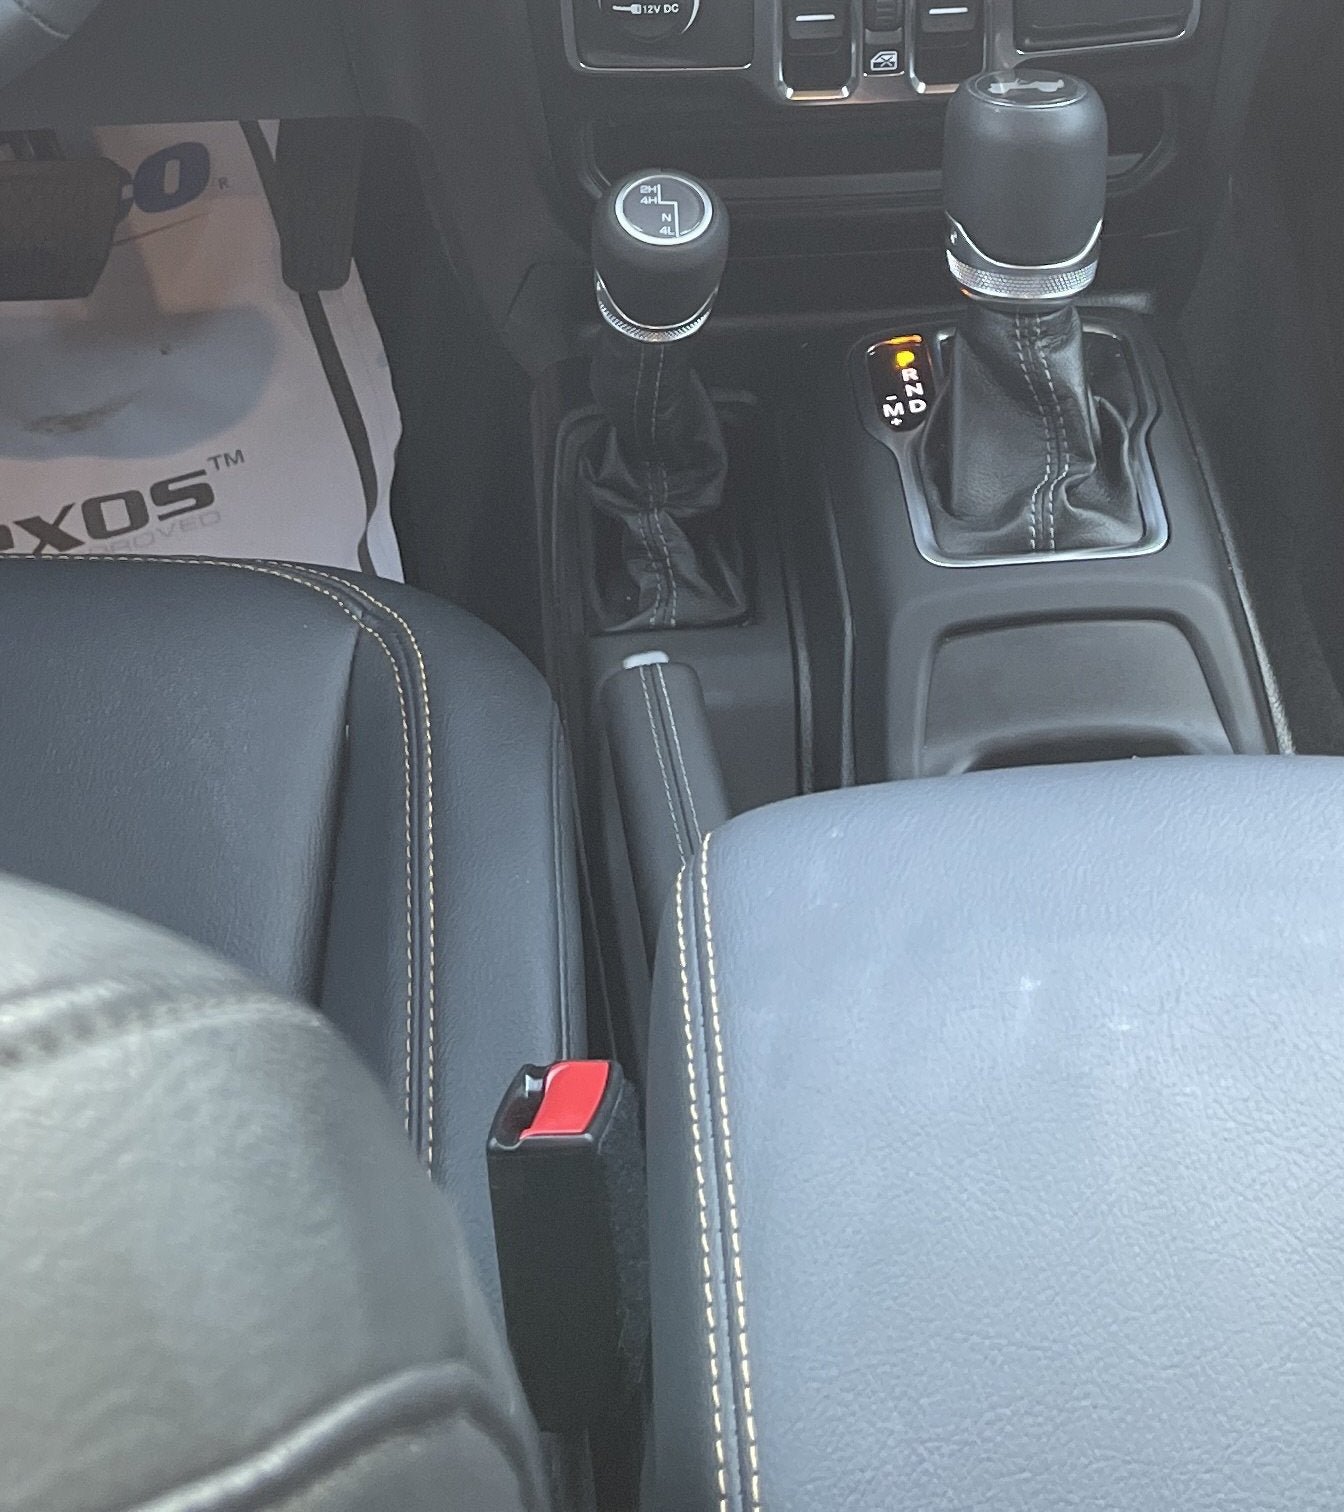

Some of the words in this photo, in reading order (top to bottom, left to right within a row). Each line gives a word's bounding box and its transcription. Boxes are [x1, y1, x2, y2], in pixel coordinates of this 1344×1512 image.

[643, 4, 661, 14] 12V
[664, 3, 680, 14] DC
[640, 185, 657, 194] 2H
[640, 196, 657, 205] 4H
[662, 213, 672, 222] N
[659, 226, 675, 236] 4L
[902, 368, 919, 382] R
[905, 383, 924, 397] N
[883, 402, 905, 418] M
[909, 399, 927, 413] D
